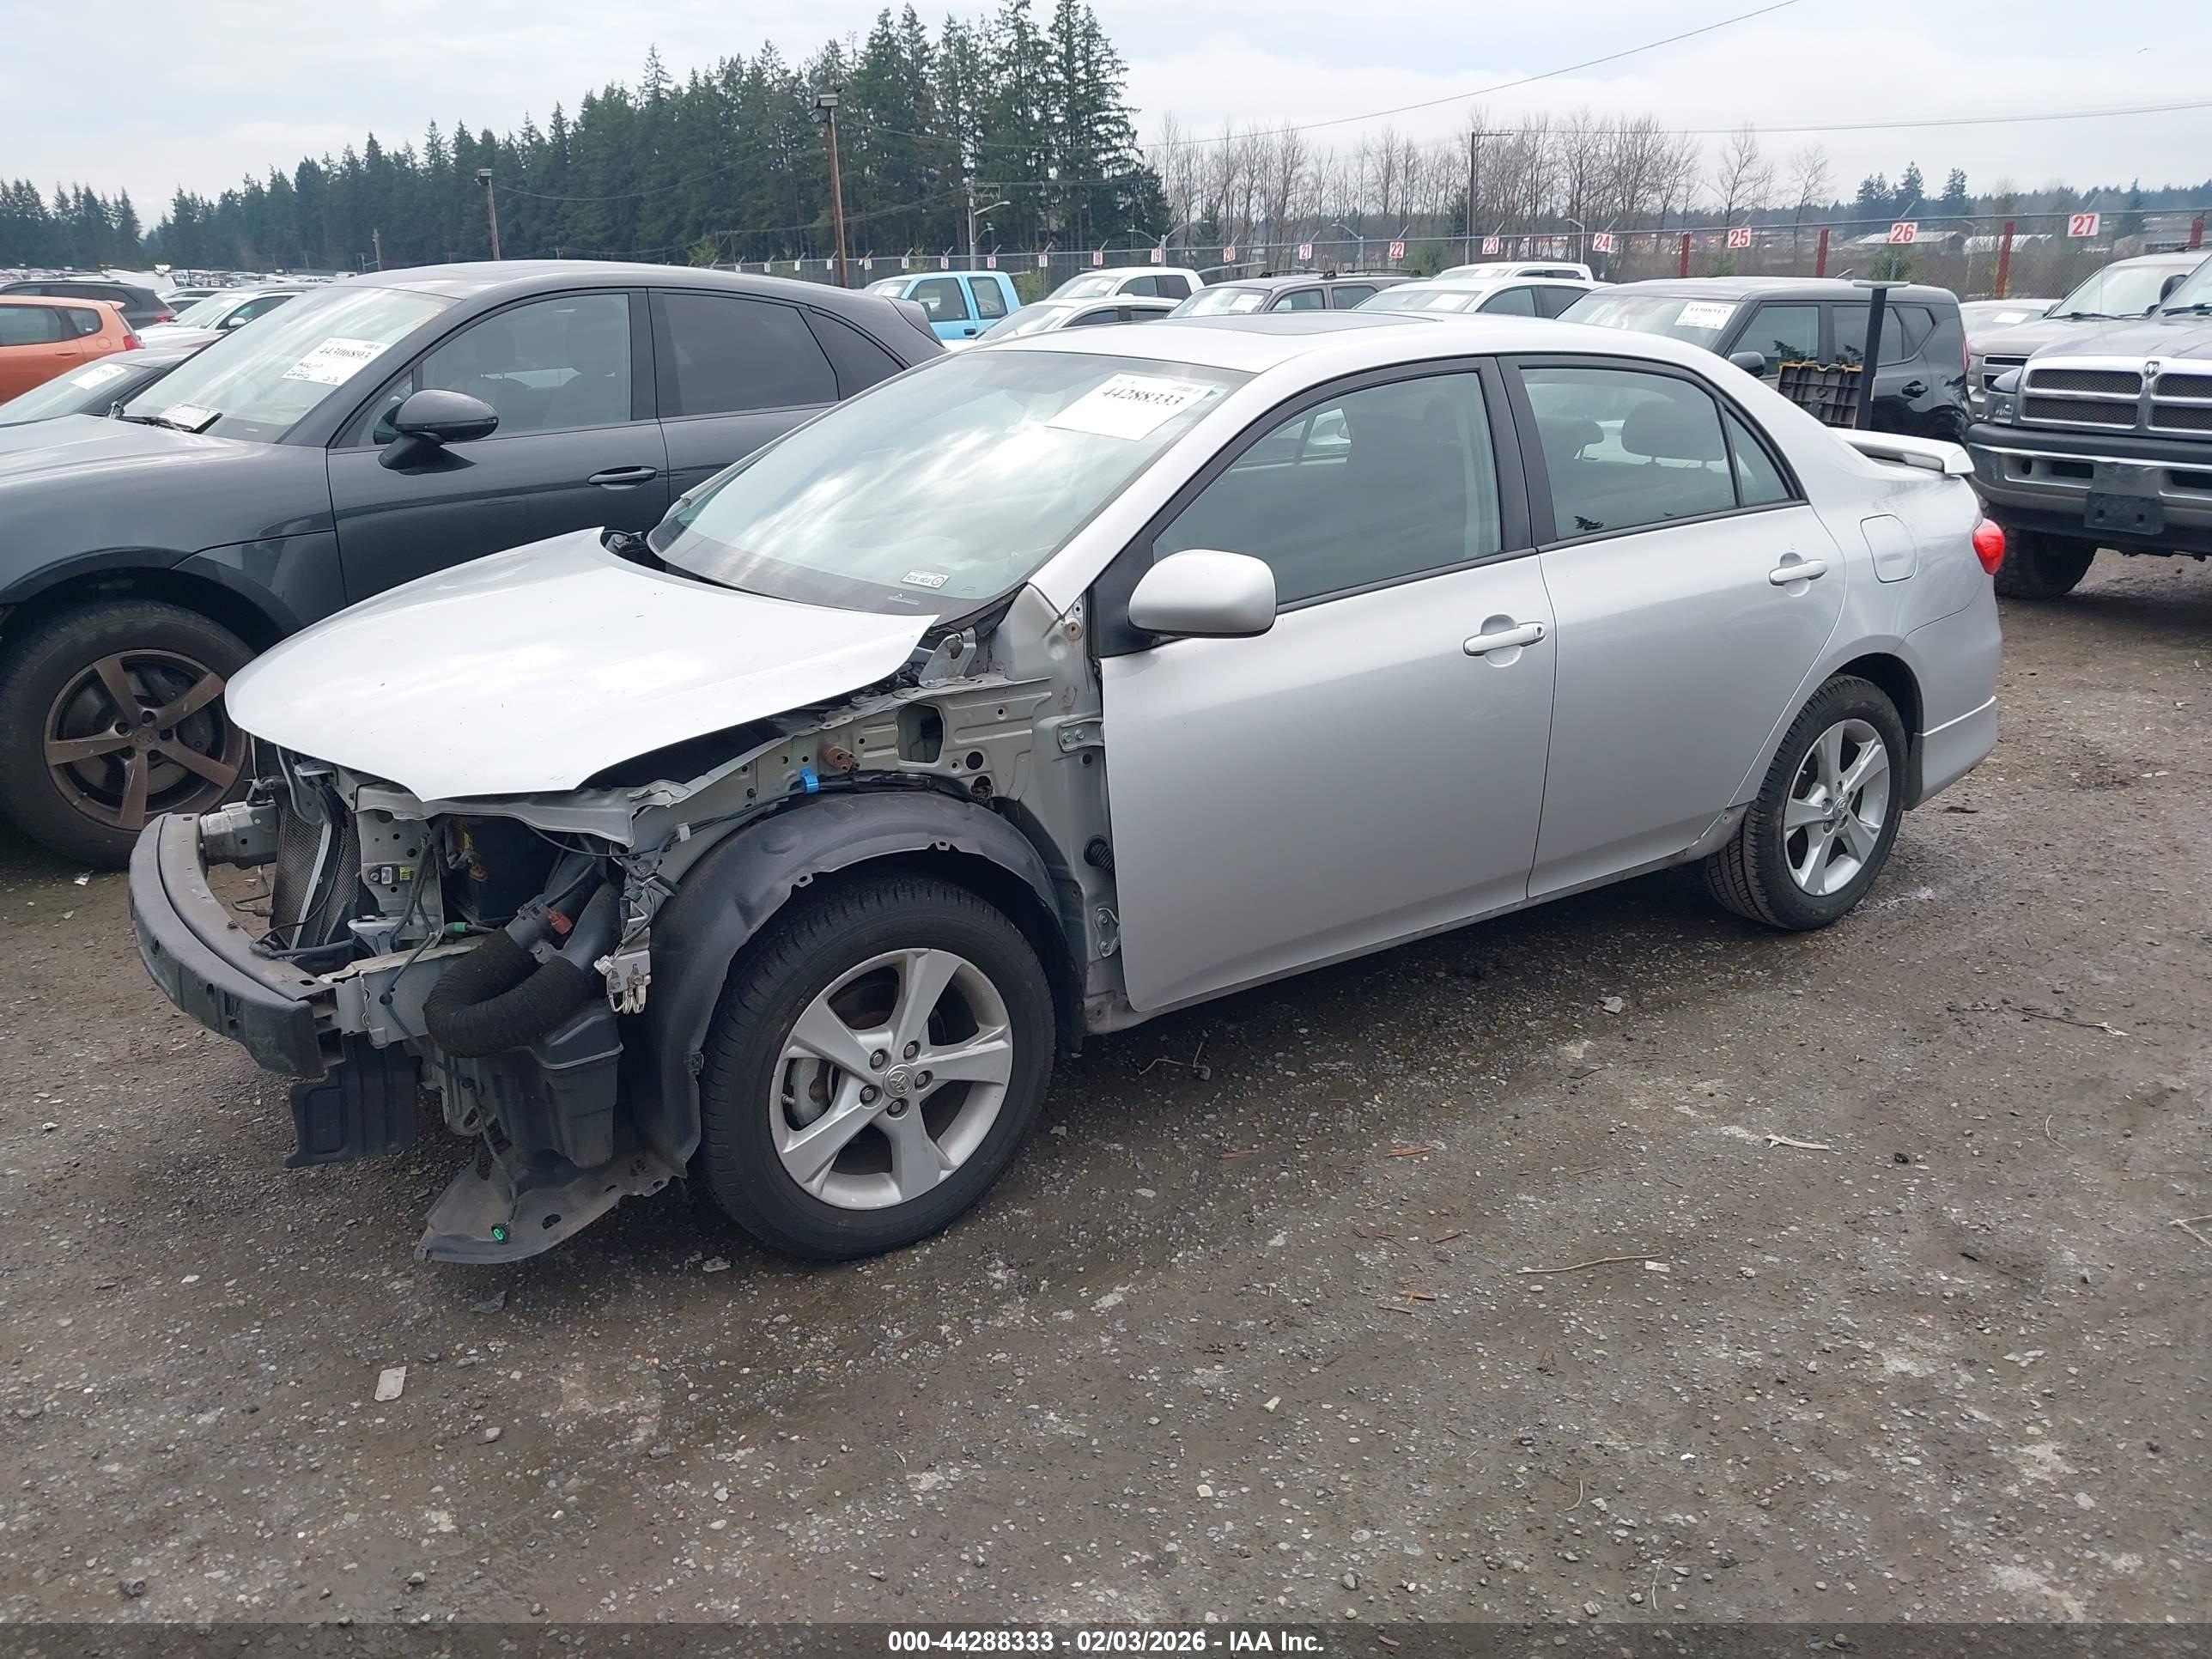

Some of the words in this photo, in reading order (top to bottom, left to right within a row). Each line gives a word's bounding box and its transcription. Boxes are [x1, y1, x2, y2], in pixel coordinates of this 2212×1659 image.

[1892, 223, 1915, 242] 26
[2072, 216, 2095, 235] 27
[1595, 234, 1610, 250] 24
[1729, 229, 1749, 247] 25
[1302, 245, 1310, 258] 21
[1390, 243, 1402, 257] 22
[1484, 239, 1497, 252] 23
[1152, 250, 1161, 262] 19
[1224, 247, 1235, 261] 20
[319, 346, 372, 360] 44306893
[1102, 387, 1185, 406] 44288333
